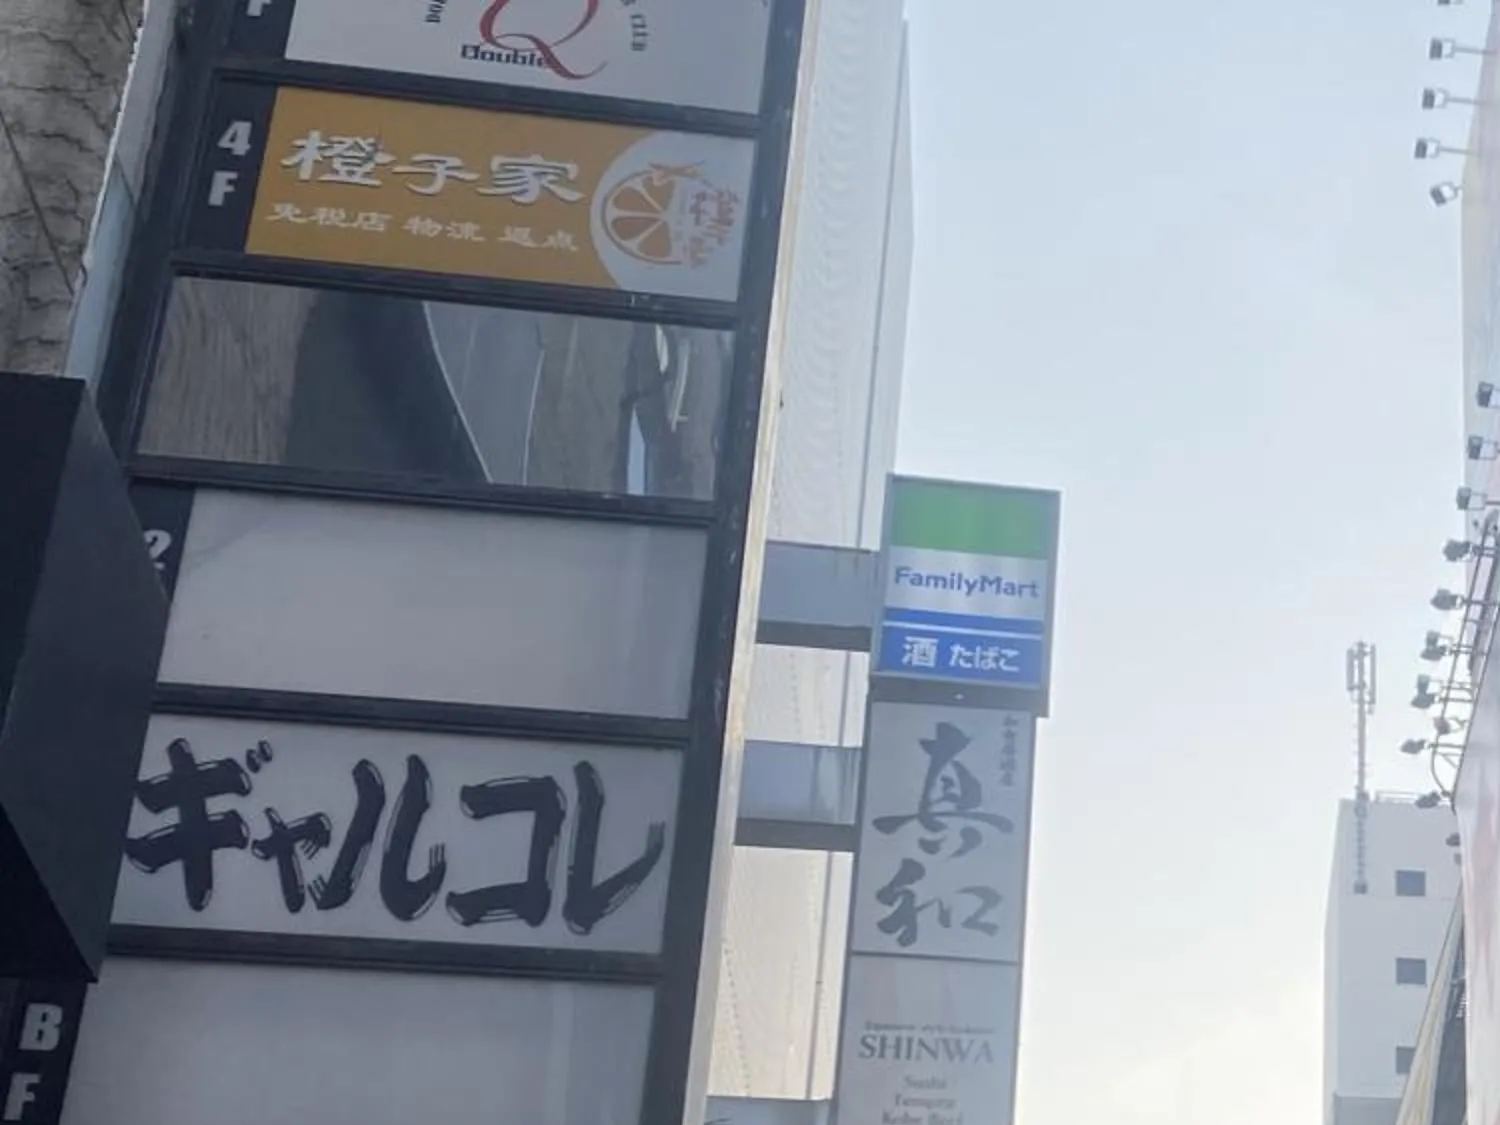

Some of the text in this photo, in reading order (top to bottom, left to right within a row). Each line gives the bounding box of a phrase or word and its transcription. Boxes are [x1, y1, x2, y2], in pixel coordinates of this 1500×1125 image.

[281, 130, 586, 206] 橙子家
[893, 565, 1039, 598] FamilyMart
[902, 635, 1021, 673] 酒 たばこ
[122, 735, 667, 935] ギャルコレ
[870, 722, 1014, 949] 真和
[858, 1034, 995, 1063] SHINWA
